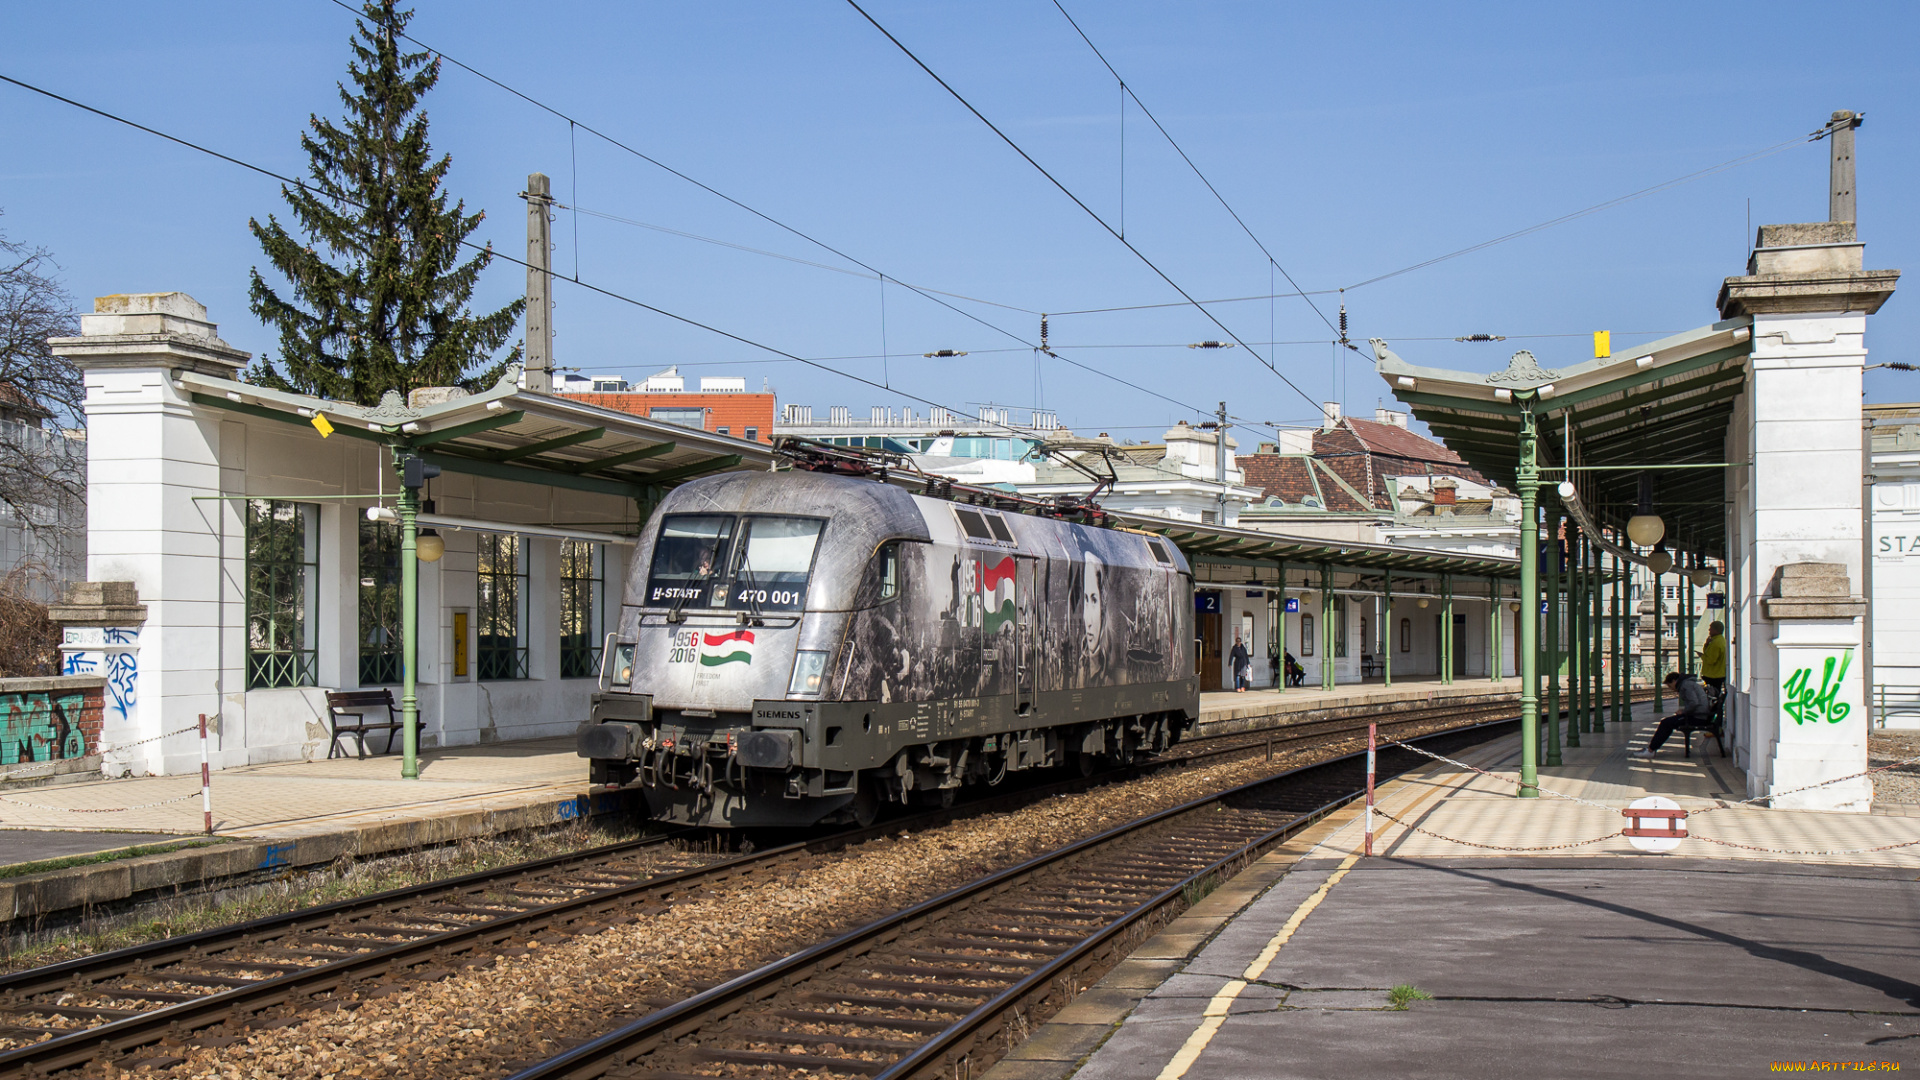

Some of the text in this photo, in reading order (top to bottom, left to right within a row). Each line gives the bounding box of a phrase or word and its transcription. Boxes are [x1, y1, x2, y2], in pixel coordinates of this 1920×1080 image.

[653, 587, 799, 605] H-START 470 001
[1206, 597, 1215, 610] 2
[961, 595, 981, 627] 2016
[1542, 602, 1549, 612] 2
[672, 632, 699, 647] 1956
[668, 648, 696, 663] 2016
[757, 710, 801, 719] SIEMENS
